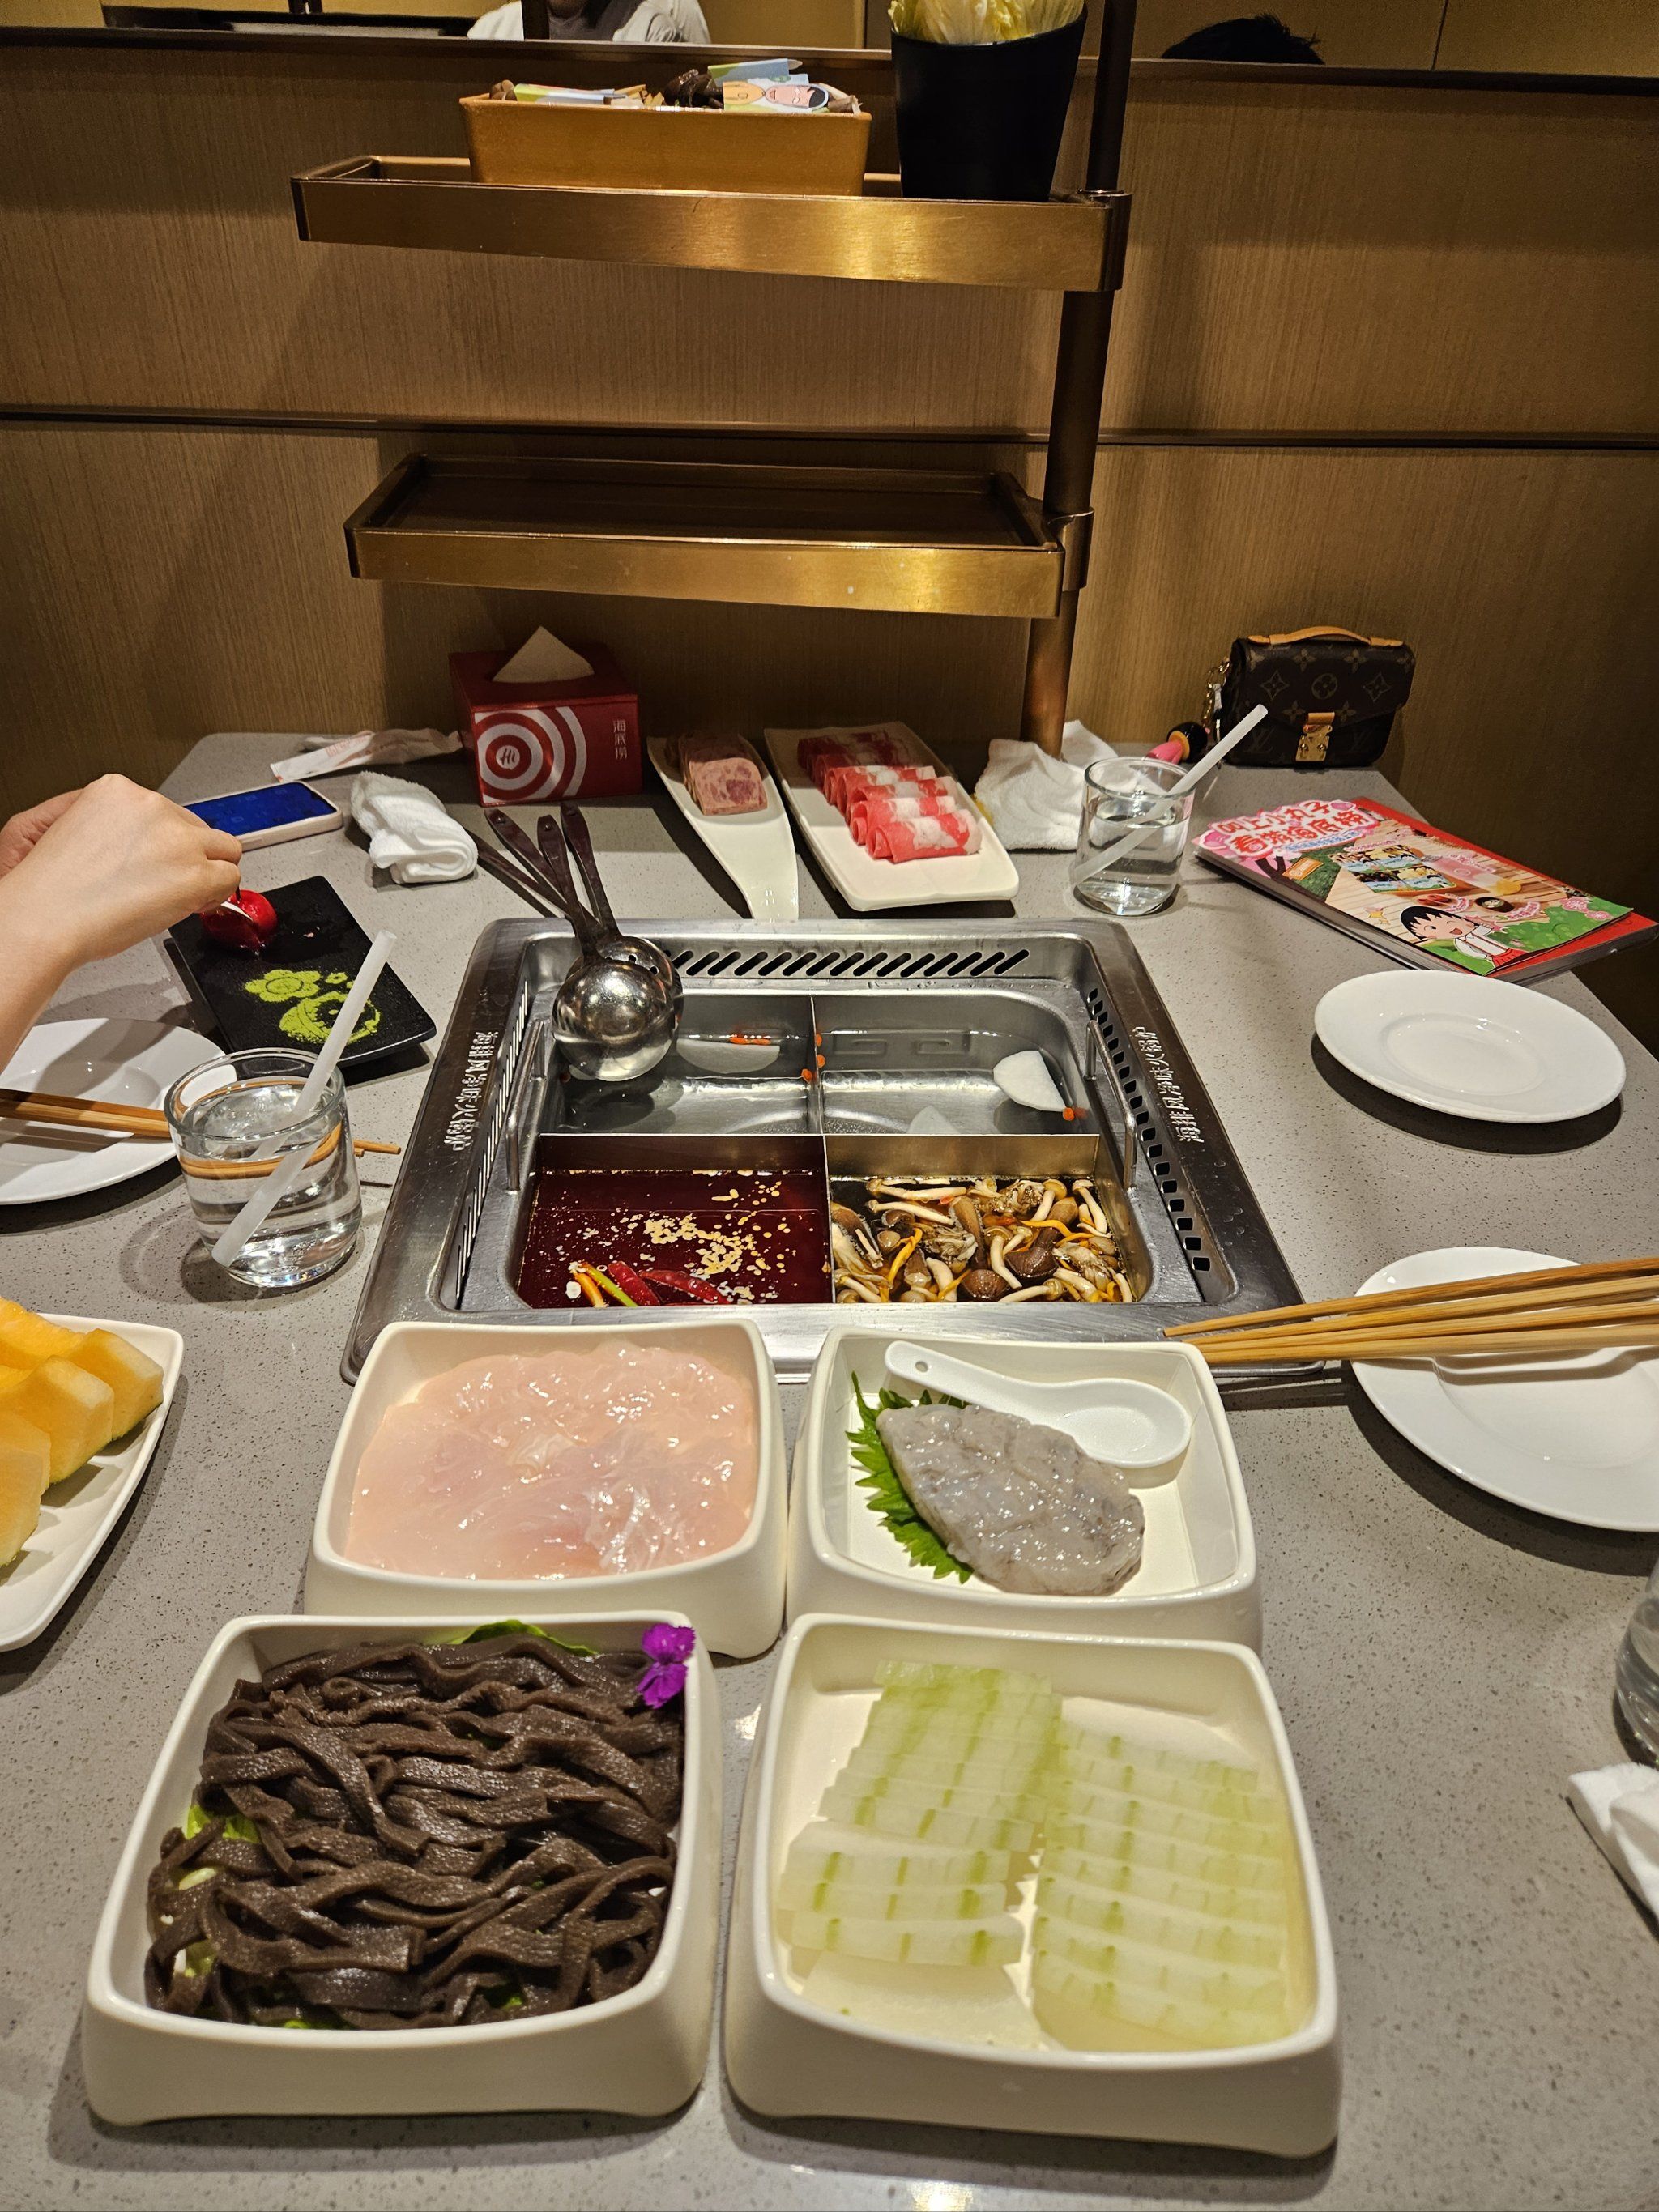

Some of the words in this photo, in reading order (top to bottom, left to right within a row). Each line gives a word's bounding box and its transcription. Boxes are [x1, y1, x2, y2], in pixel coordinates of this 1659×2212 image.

[613, 719, 628, 760] 海底捞
[443, 1030, 499, 1152] 海排风净味火锅炉
[1132, 1025, 1205, 1144] 海排风净味火锅炉
